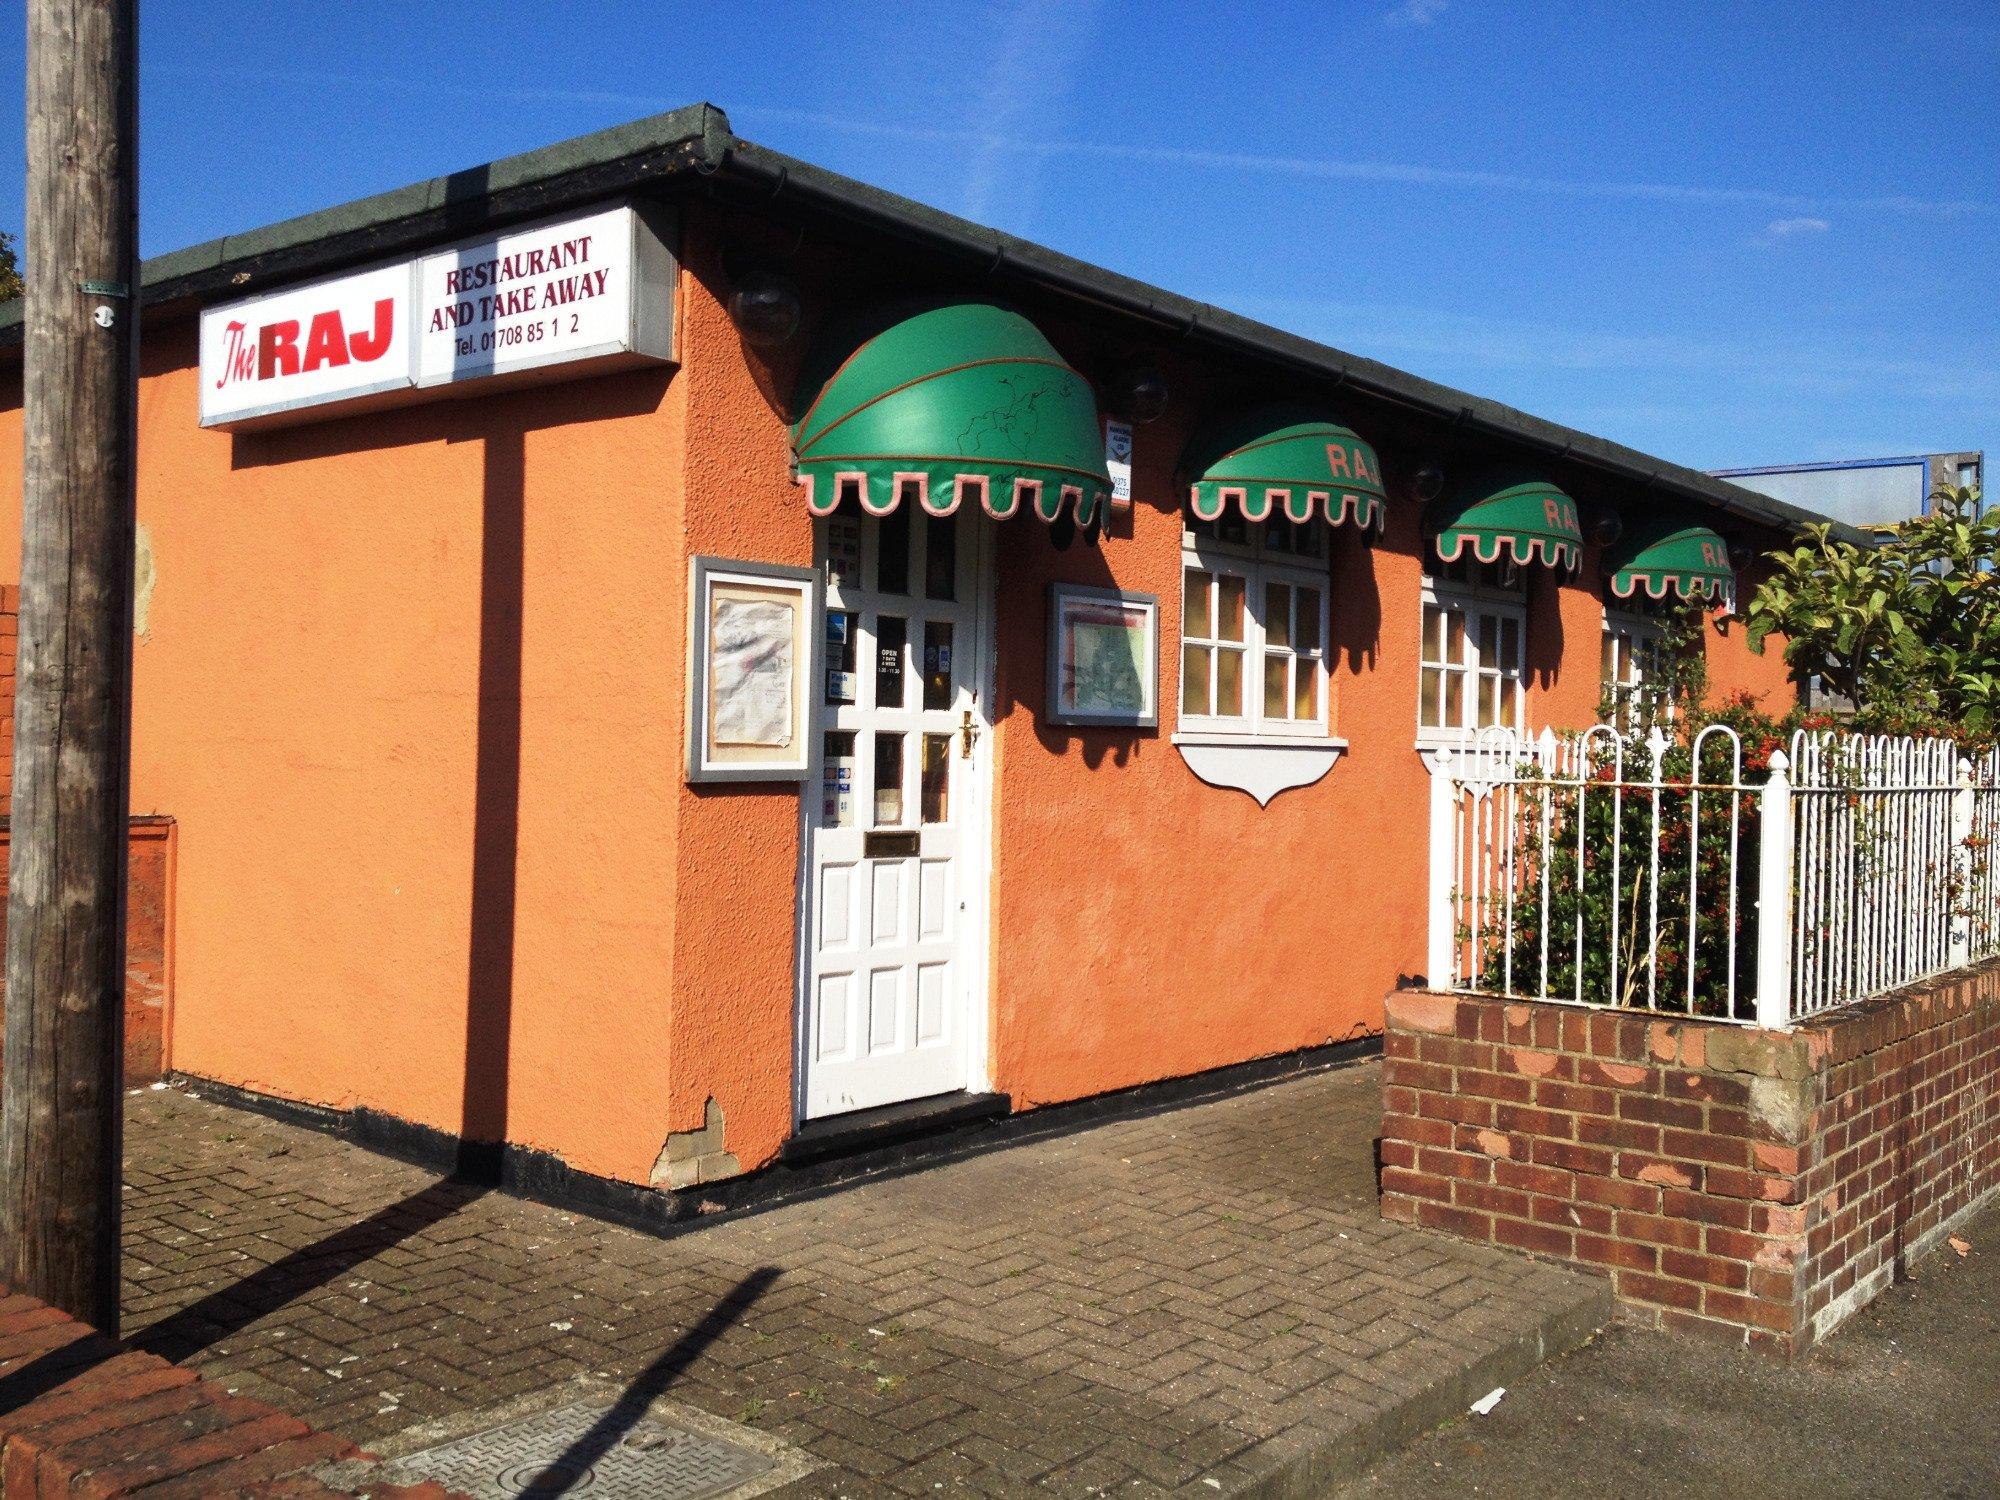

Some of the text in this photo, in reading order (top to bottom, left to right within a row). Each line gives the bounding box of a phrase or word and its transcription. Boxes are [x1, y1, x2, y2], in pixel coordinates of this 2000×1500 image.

[445, 236, 593, 296] RESTAURANT
[429, 268, 610, 334] AND TAKE AWAY
[216, 298, 394, 390] The RAJ
[455, 337, 476, 357] Tel.
[481, 325, 523, 352] 01708
[527, 321, 544, 343] 85
[570, 313, 579, 334] 2
